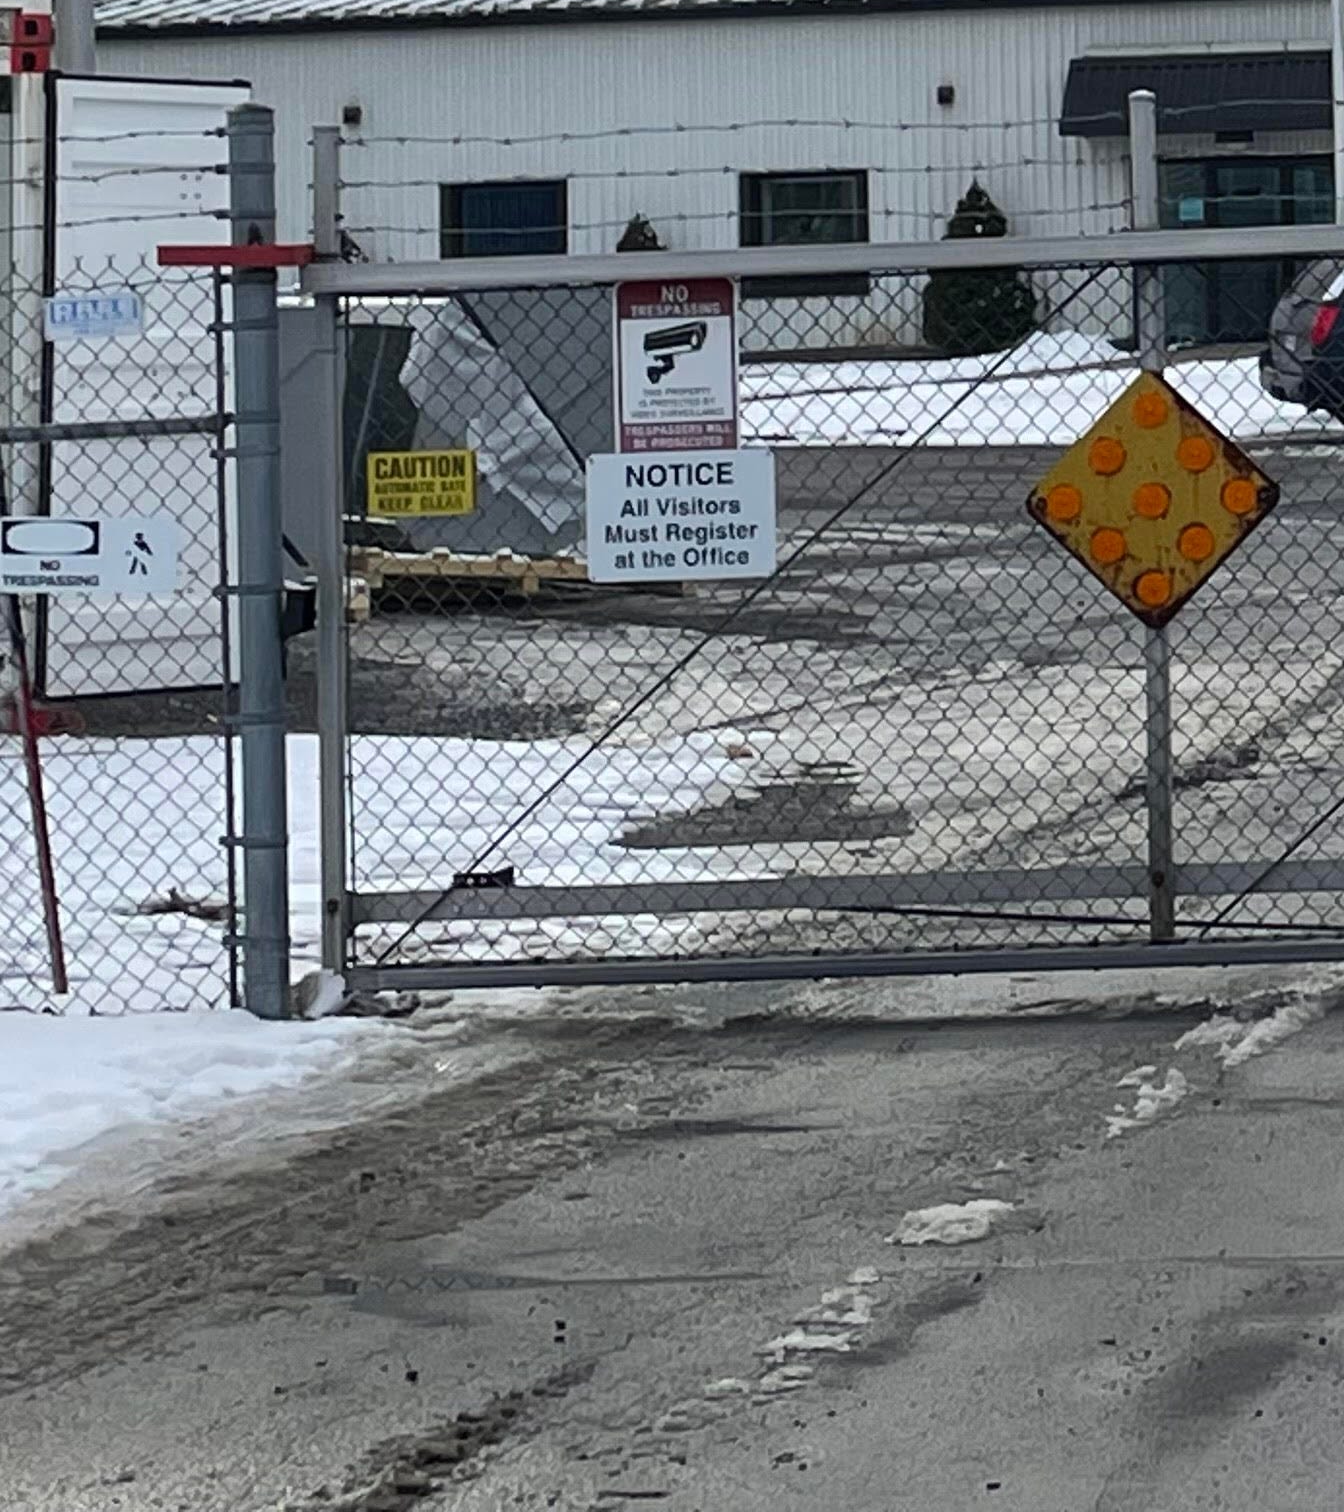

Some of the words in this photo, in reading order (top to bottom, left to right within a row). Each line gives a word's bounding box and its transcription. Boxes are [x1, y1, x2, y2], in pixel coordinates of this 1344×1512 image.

[661, 285, 689, 303] NO
[375, 455, 466, 480] CAUTION
[625, 462, 735, 488] NOTICE
[620, 498, 649, 518] All
[655, 497, 742, 517] Visitors
[604, 523, 658, 544] Must
[666, 521, 759, 546] Register
[40, 560, 61, 571] NO
[614, 550, 635, 569] at
[642, 549, 676, 568] the
[682, 547, 750, 567] Office
[2, 574, 100, 587] TRESPASSING
